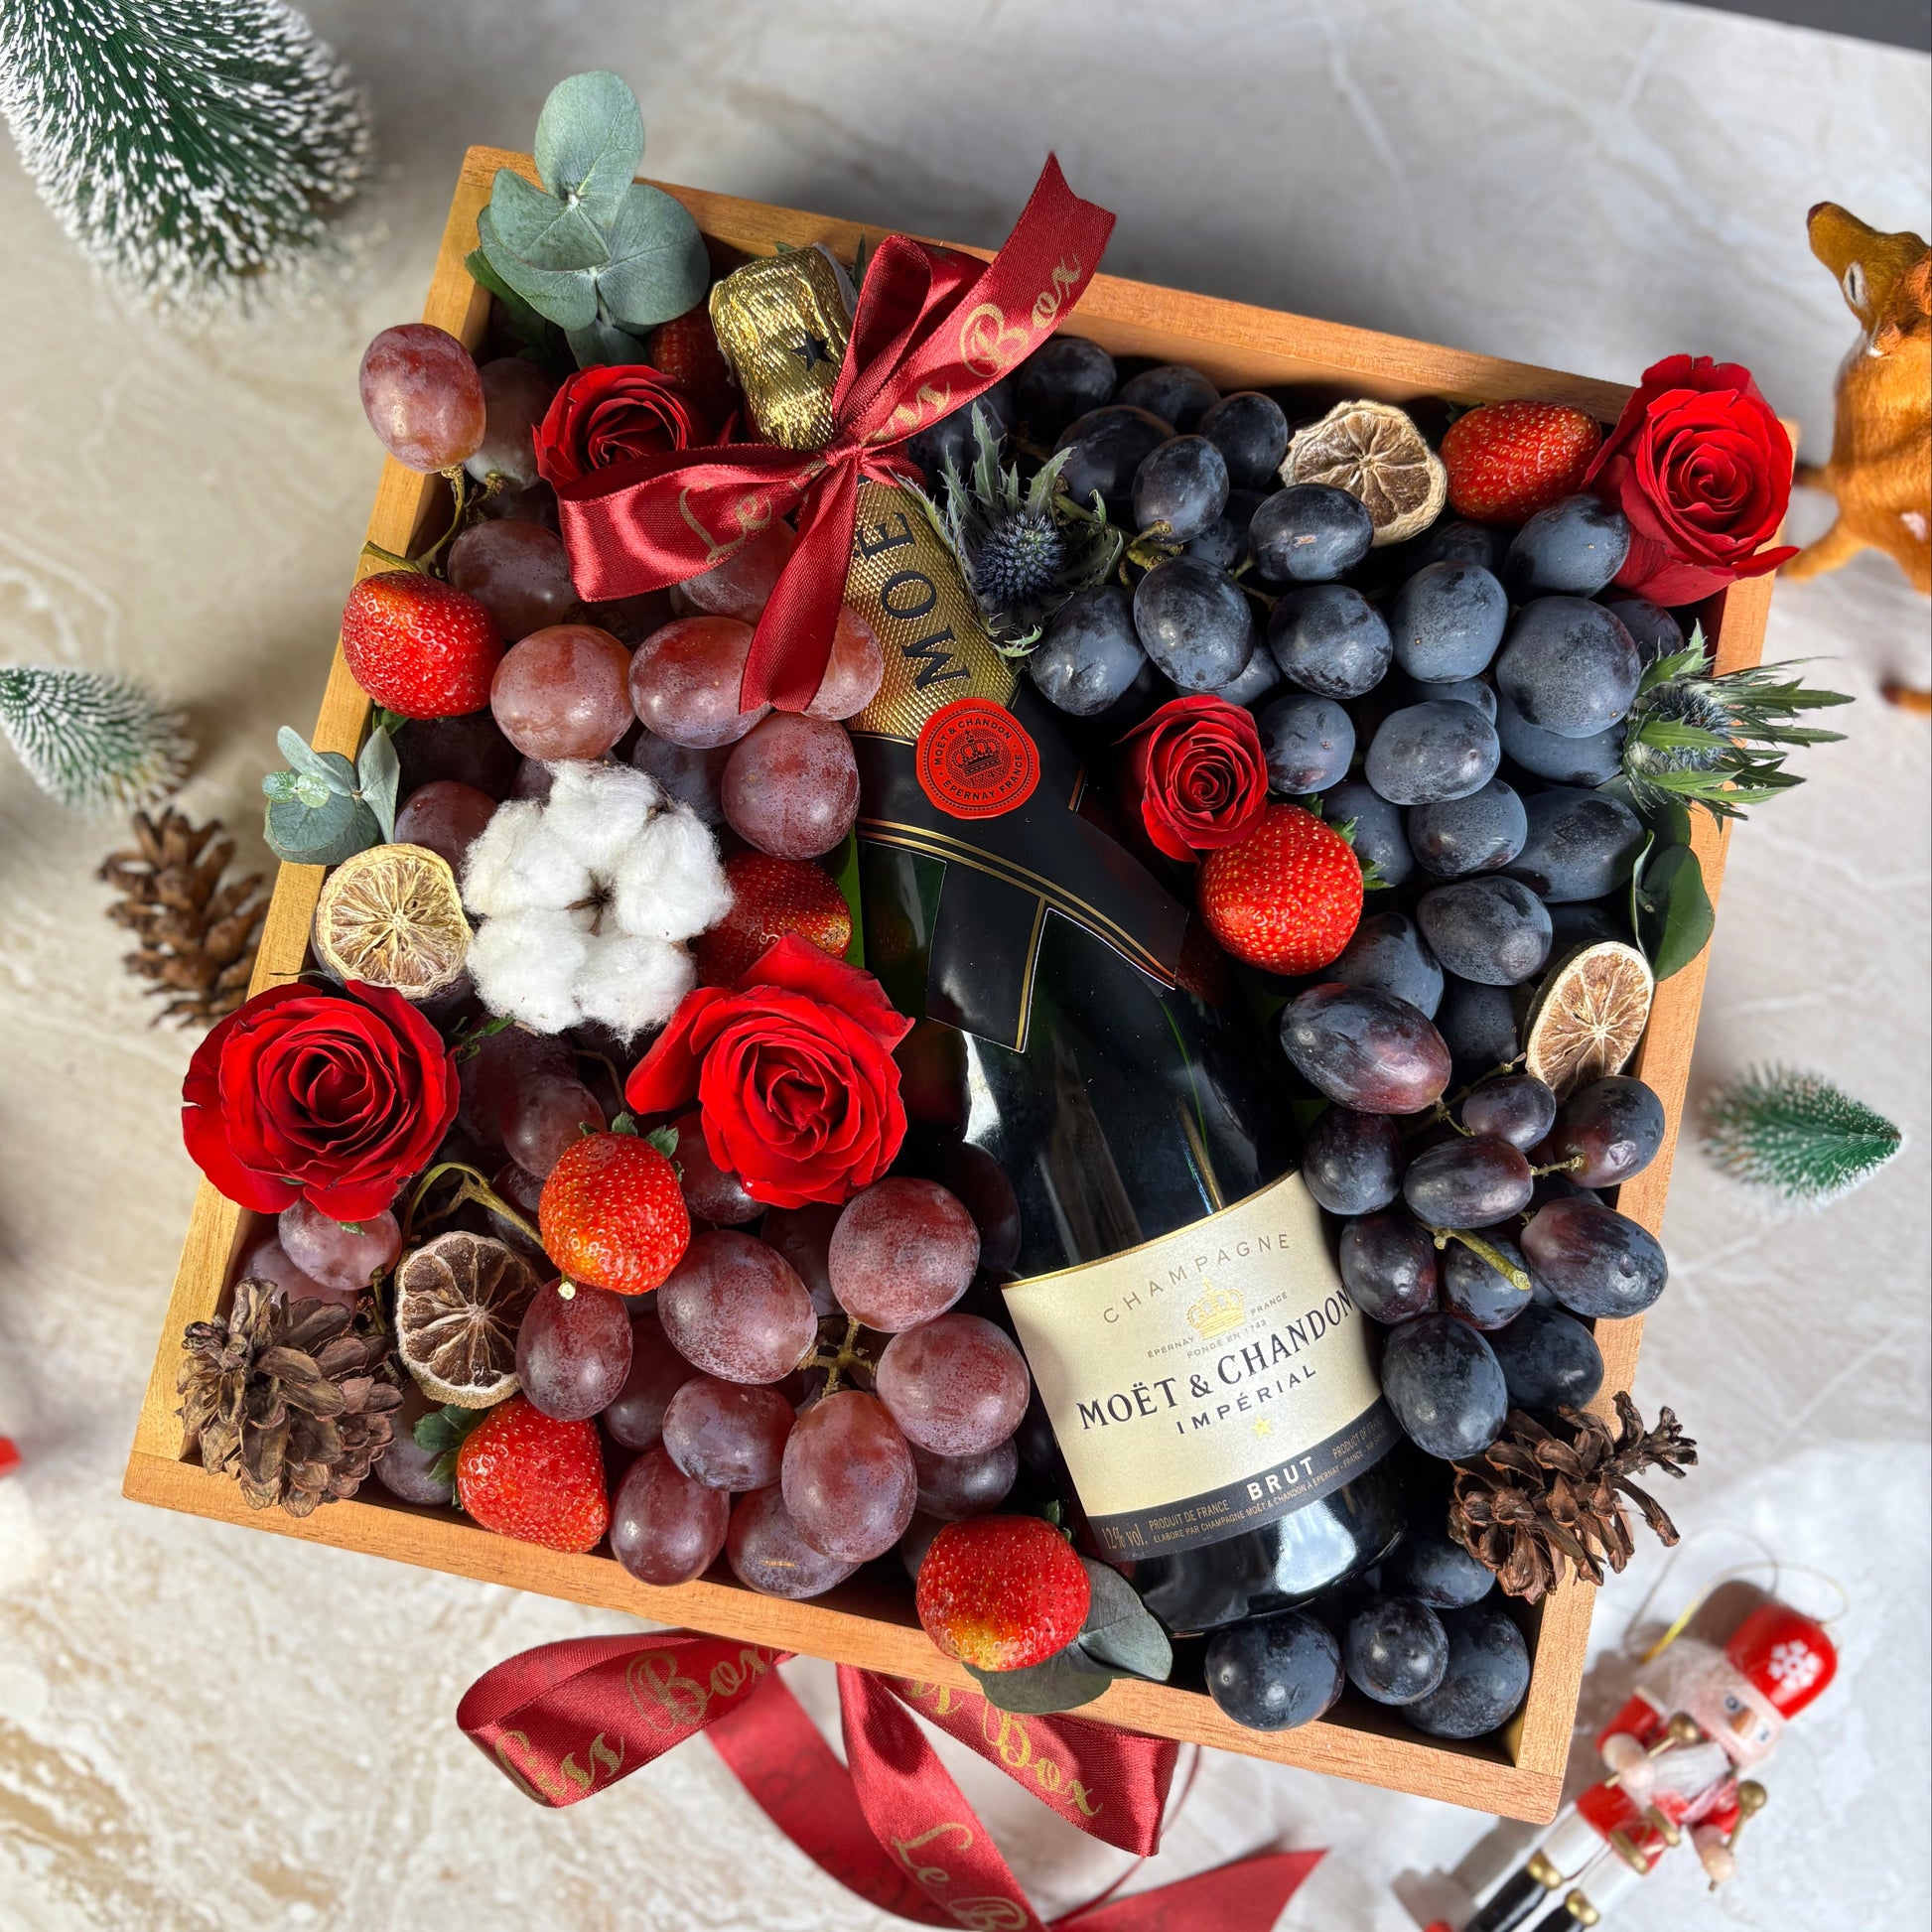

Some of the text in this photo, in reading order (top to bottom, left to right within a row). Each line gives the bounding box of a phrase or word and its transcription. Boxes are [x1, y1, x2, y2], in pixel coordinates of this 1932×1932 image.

[959, 253, 1083, 378] Box
[854, 473, 972, 692] MOË
[957, 718, 1013, 740] CHANDON
[999, 754, 1024, 793] FRANCE
[1103, 1232, 1291, 1323] CHAMPAGNE
[1250, 1291, 1289, 1316] FRANCE
[1226, 1331, 1241, 1343] EN
[1244, 1318, 1268, 1335] 1743
[1075, 1285, 1355, 1432] MOËT & CHANDON
[1175, 1365, 1316, 1435] IMPÉRIAL
[1331, 1433, 1361, 1459] PRODUCT
[1246, 1455, 1312, 1501] BRUT
[1148, 1499, 1230, 1532] PRODUIT DE FRANCE
[1184, 1526, 1199, 1537] PAR
[1200, 1511, 1246, 1532] CHAMPAGNE
[1273, 1483, 1307, 1506] CHANDON
[1101, 1523, 1149, 1550] 12% vol.
[625, 1644, 774, 1733] Box
[891, 1821, 974, 1884] Le
